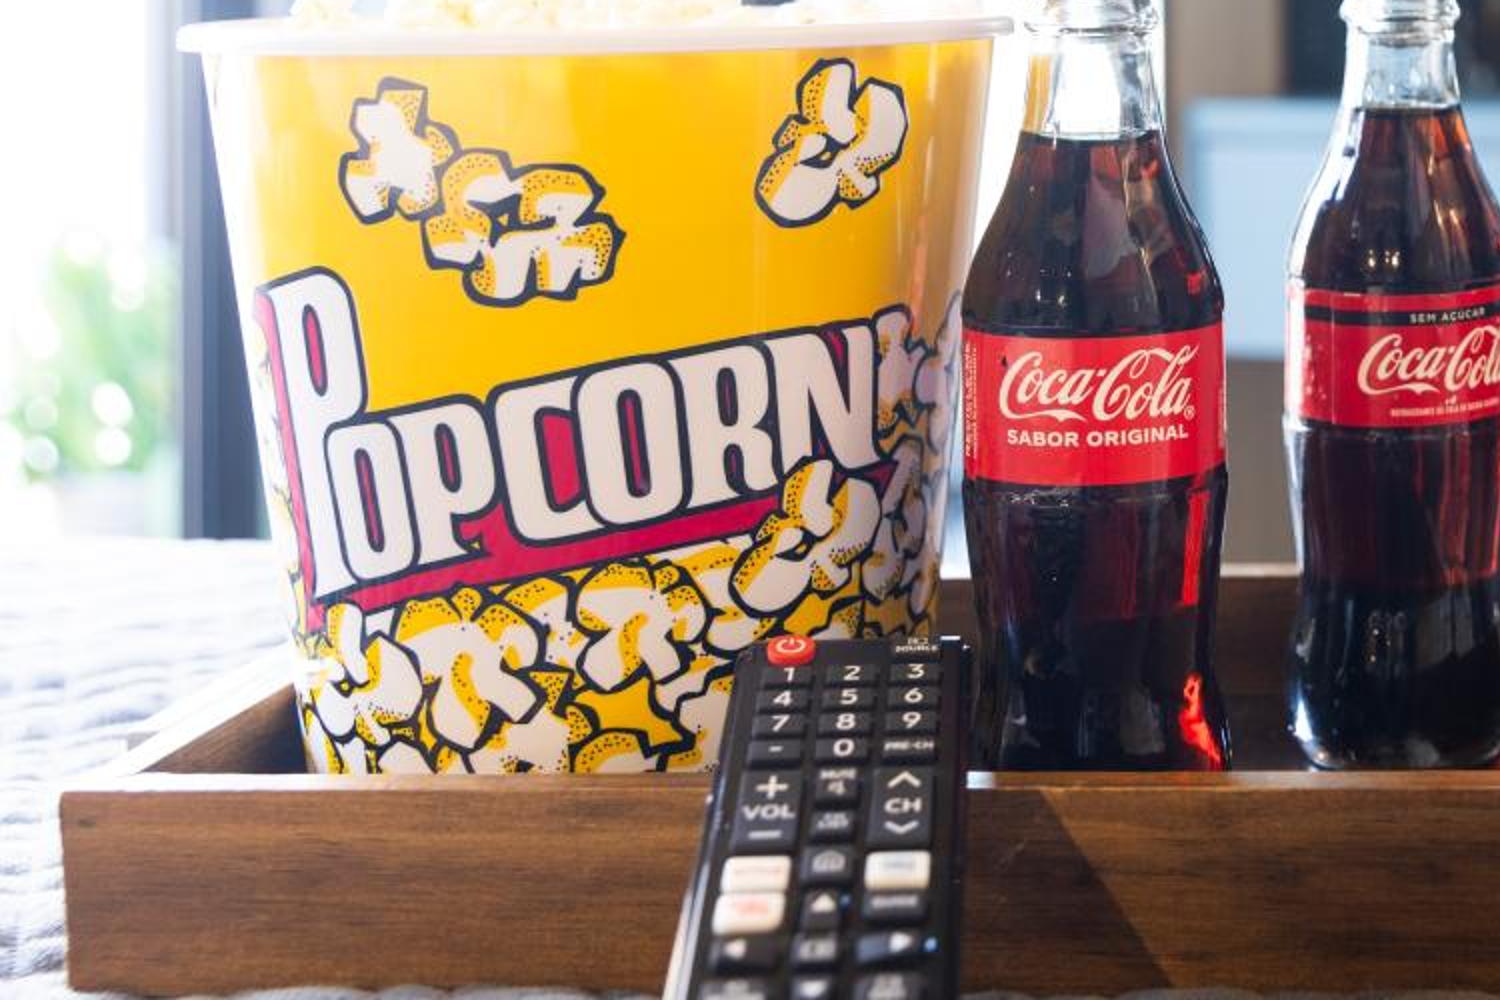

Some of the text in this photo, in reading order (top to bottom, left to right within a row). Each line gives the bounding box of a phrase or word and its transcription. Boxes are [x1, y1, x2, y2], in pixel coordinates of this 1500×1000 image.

[1409, 313, 1436, 324] SEM
[999, 345, 1199, 422] Coca-Cola
[266, 268, 884, 600] POPCORN
[1007, 424, 1189, 446] SABOR ORIGINAL
[784, 667, 794, 681] 1
[844, 666, 860, 680] 2
[908, 664, 924, 678] 3
[774, 691, 791, 706] 4
[841, 689, 857, 704] 5
[905, 688, 923, 703] 6
[772, 715, 789, 731] 7
[836, 714, 855, 730] 8
[903, 712, 921, 728] 9
[833, 739, 854, 756] 0
[743, 805, 794, 820] VOL
[885, 798, 921, 813] CH
